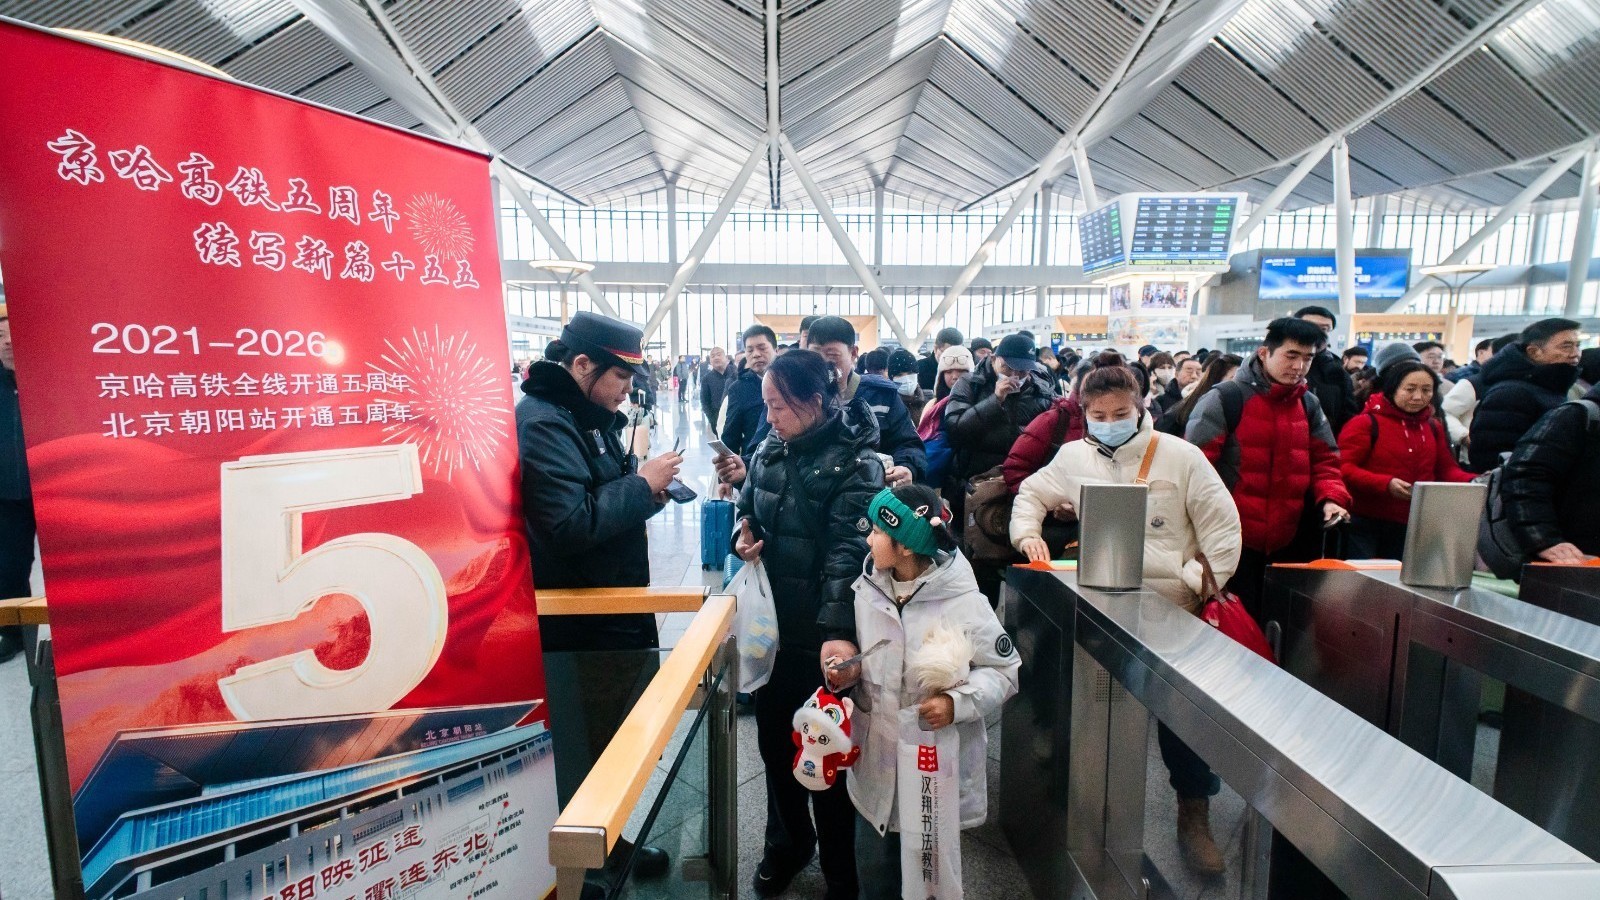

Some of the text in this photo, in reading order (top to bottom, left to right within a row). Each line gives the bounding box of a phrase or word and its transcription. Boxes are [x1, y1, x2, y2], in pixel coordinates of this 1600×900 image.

[47, 128, 402, 234] 京哈高铁五周年
[193, 222, 481, 290] 续写新篇十五五
[96, 372, 411, 400] 京哈高铁全线开通五周年
[102, 402, 413, 438] 北京朝阳站开通五周年
[219, 444, 448, 721] 5
[425, 723, 482, 740] 北京朝阳站
[262, 825, 424, 900] 阳映征途
[921, 775, 932, 882] 汉翔书法教育
